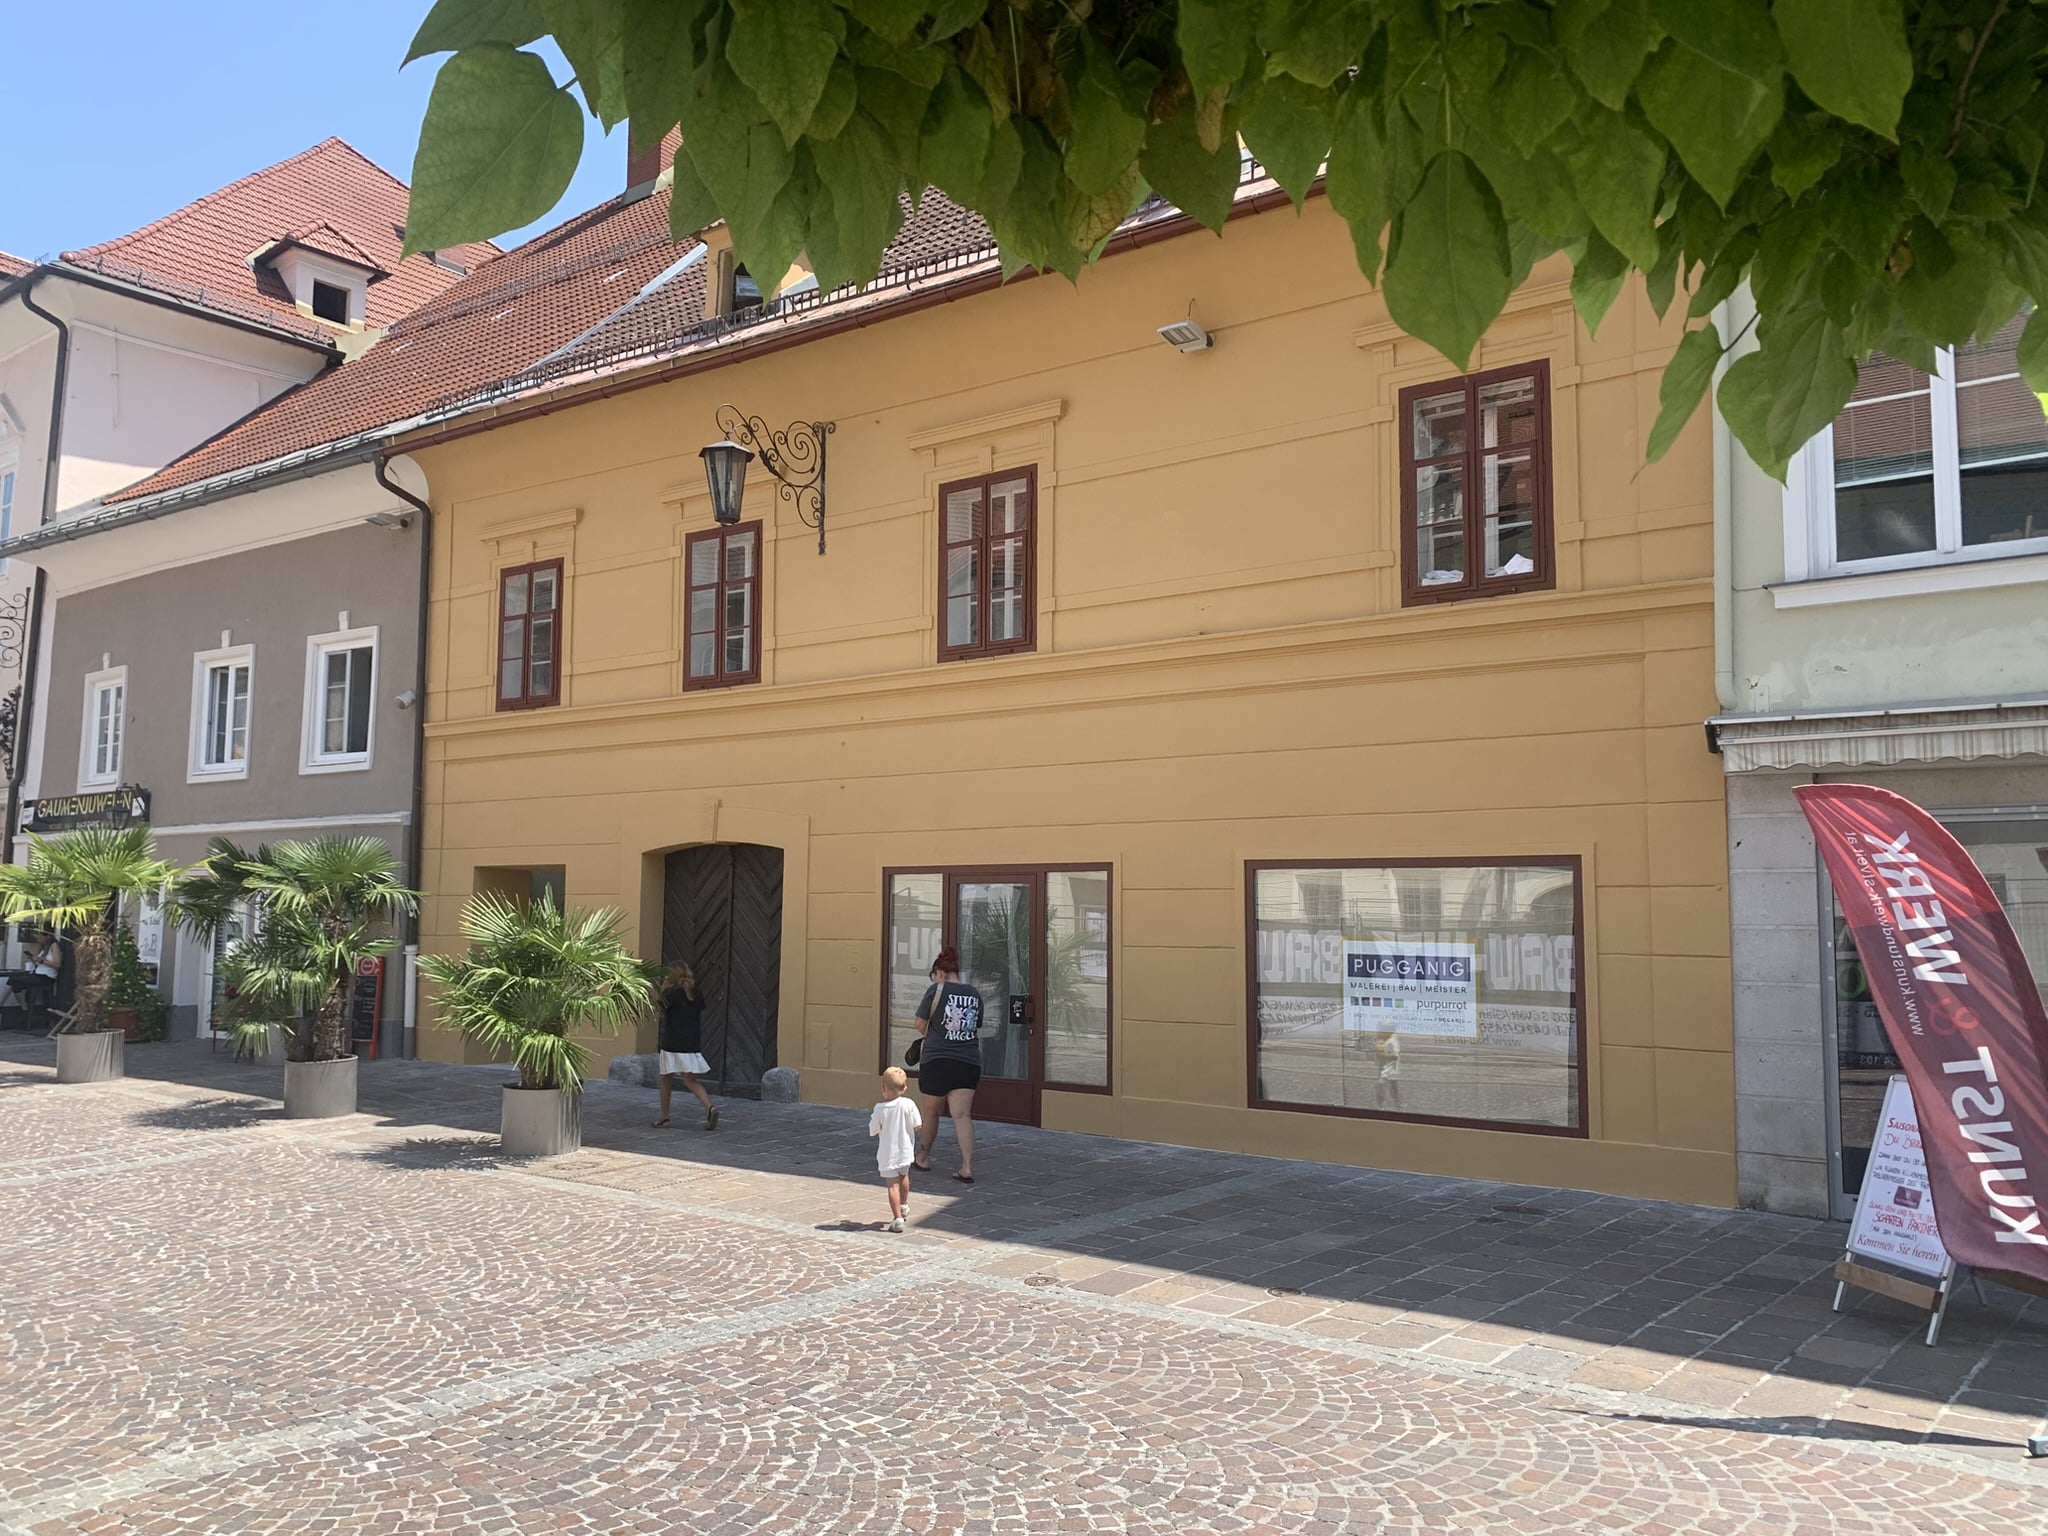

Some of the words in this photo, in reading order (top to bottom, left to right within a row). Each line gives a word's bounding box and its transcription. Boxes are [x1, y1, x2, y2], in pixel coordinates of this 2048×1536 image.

[1353, 958, 1466, 977] PUGGANIG
[1350, 981, 1390, 991] MALEREI
[1398, 984, 1417, 992] BAU
[1425, 985, 1468, 994] MEISTER
[947, 993, 979, 1008] STITCH
[1416, 1000, 1468, 1011] purpurrot
[1857, 1233, 1896, 1252] Kommen
[1896, 1243, 1911, 1256] Sie
[1912, 1245, 1945, 1262] herein!
